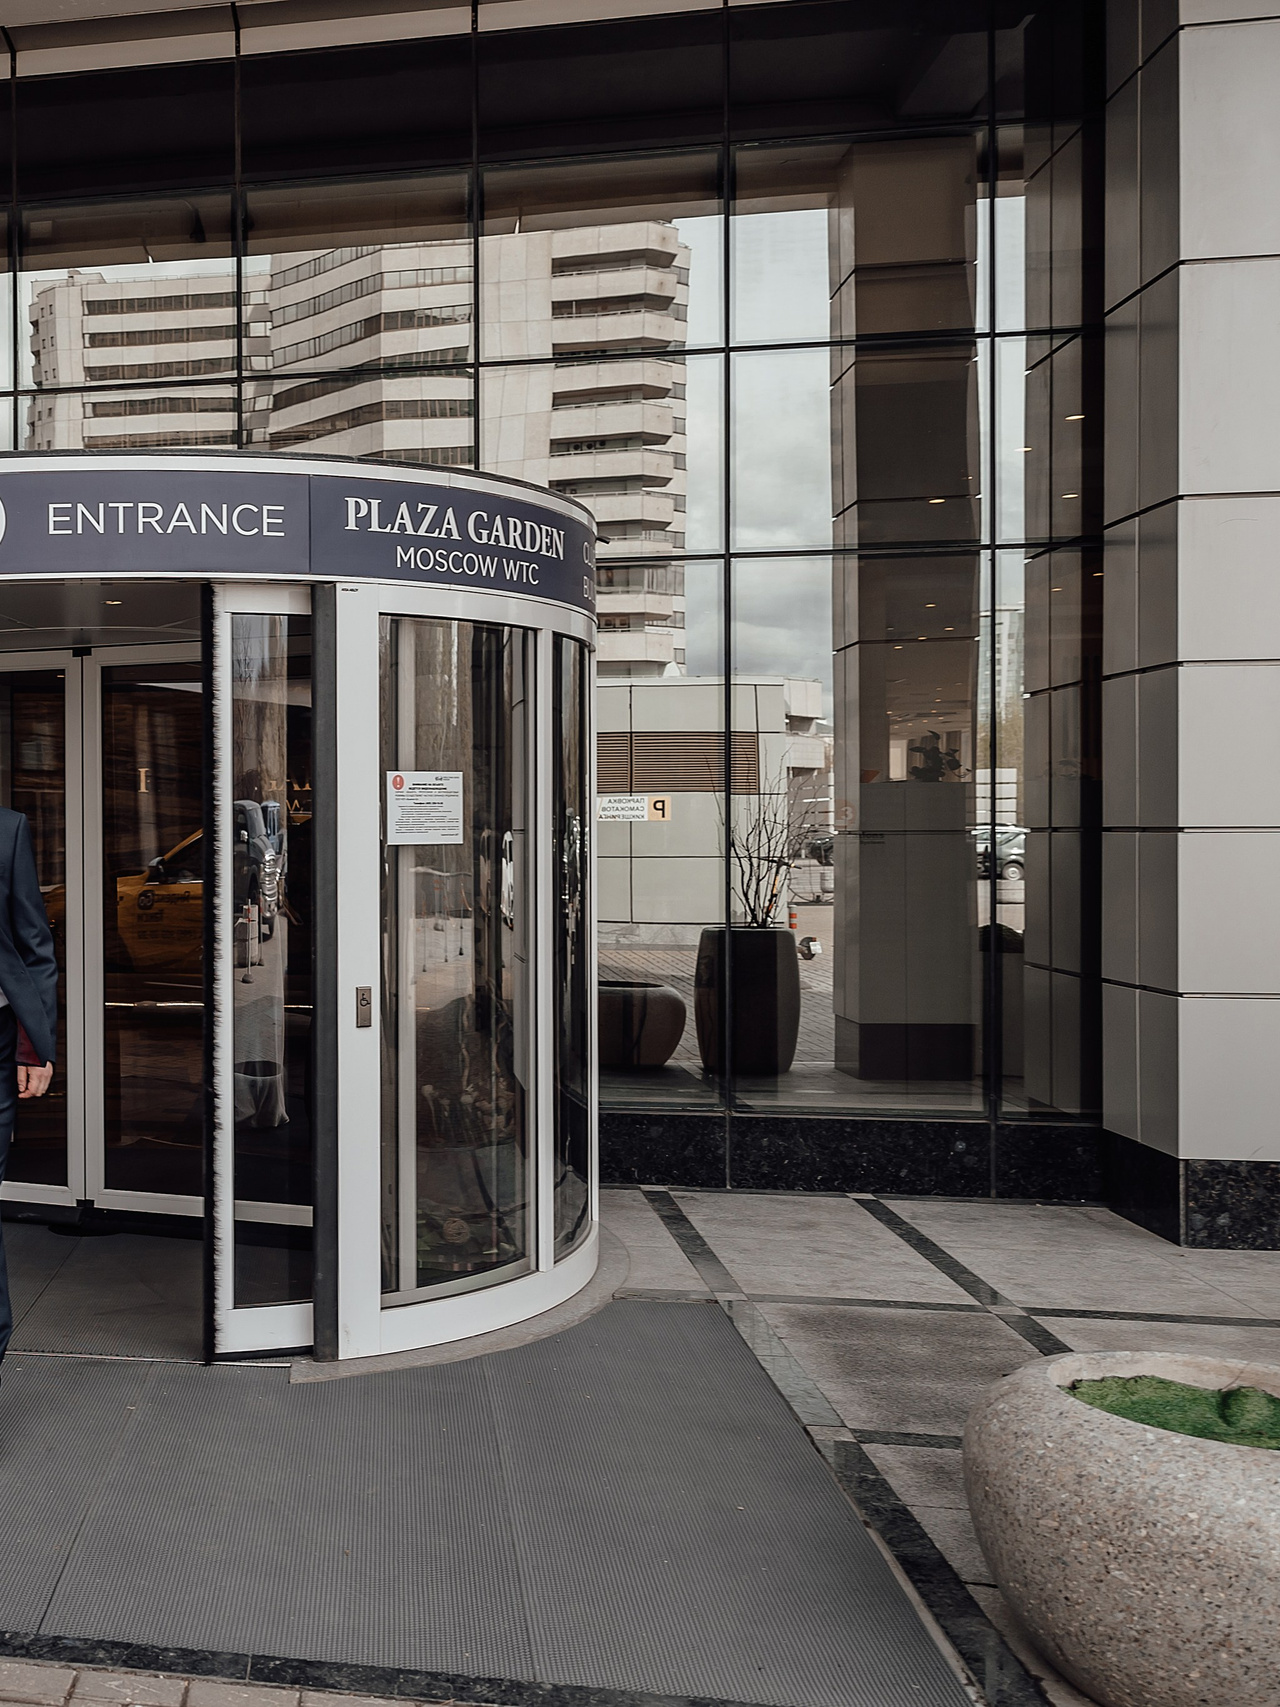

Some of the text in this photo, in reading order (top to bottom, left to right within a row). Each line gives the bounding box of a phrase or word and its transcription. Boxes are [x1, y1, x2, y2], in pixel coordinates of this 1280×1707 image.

[47, 502, 286, 538] ENTRANCE
[344, 496, 463, 541] PLAZA
[465, 510, 566, 562] GARDEN
[396, 545, 540, 586] MOSCOW WTC
